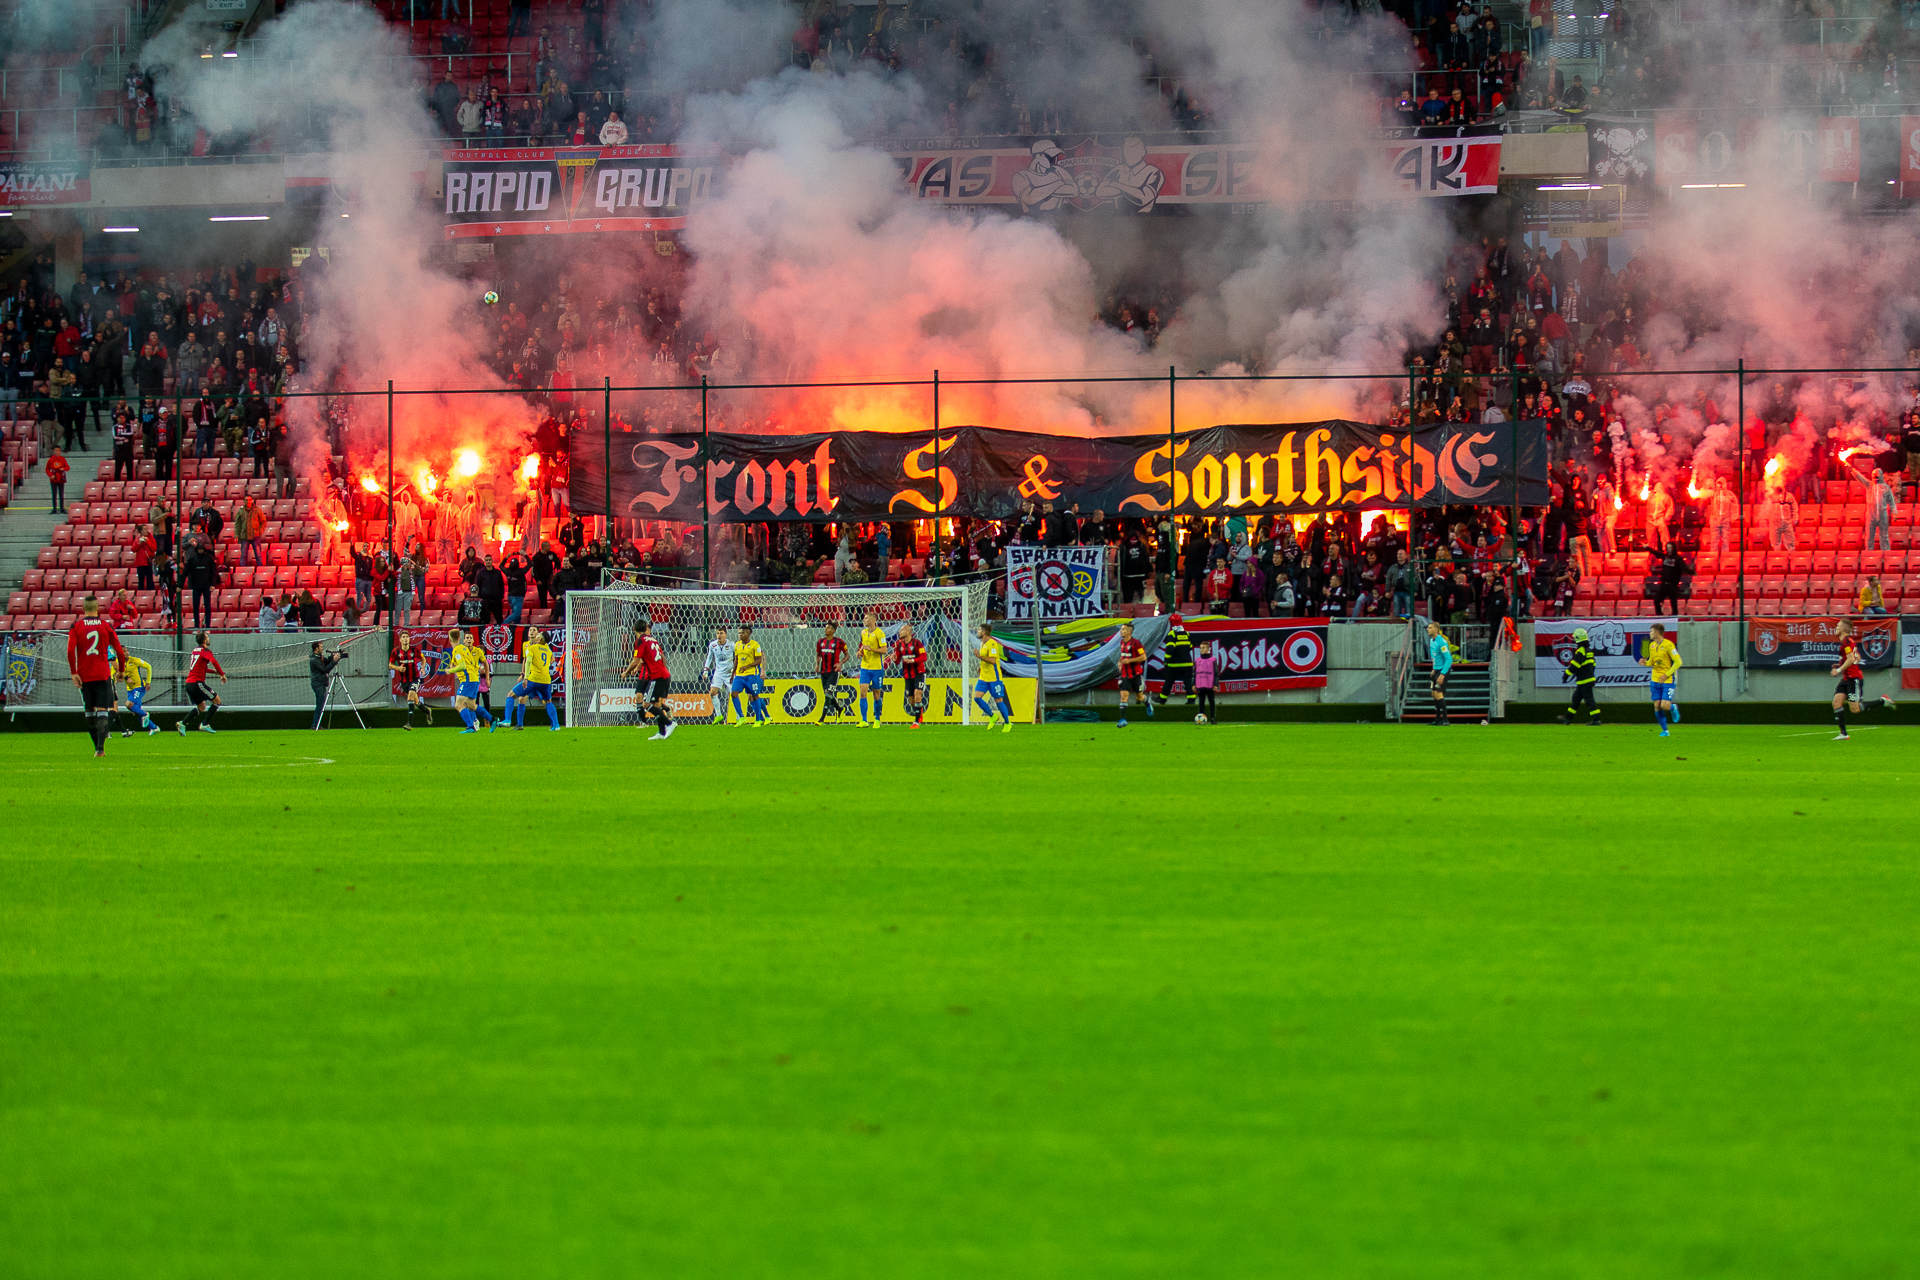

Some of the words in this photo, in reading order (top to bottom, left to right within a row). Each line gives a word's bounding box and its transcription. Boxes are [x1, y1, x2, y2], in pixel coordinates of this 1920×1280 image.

[451, 151, 509, 159] FOOTBALL
[612, 147, 662, 156] SPARTAK
[1662, 130, 1855, 174] SOTH
[1185, 144, 1464, 197] SPAK
[7, 192, 28, 204] fan
[30, 191, 58, 201] club
[445, 171, 552, 214] RAPID
[595, 167, 713, 214] GRUPO
[1552, 226, 1574, 234] EXIT
[659, 244, 675, 253] EXI
[628, 437, 839, 516] Front
[888, 434, 958, 514] S
[1016, 454, 1064, 500] &
[1011, 549, 1099, 566] SPARTAK
[86, 630, 99, 656] 2
[190, 654, 201, 671] 17
[541, 652, 548, 672] 9
[1562, 670, 1652, 684] ovanci
[1225, 682, 1249, 692] TOUR
